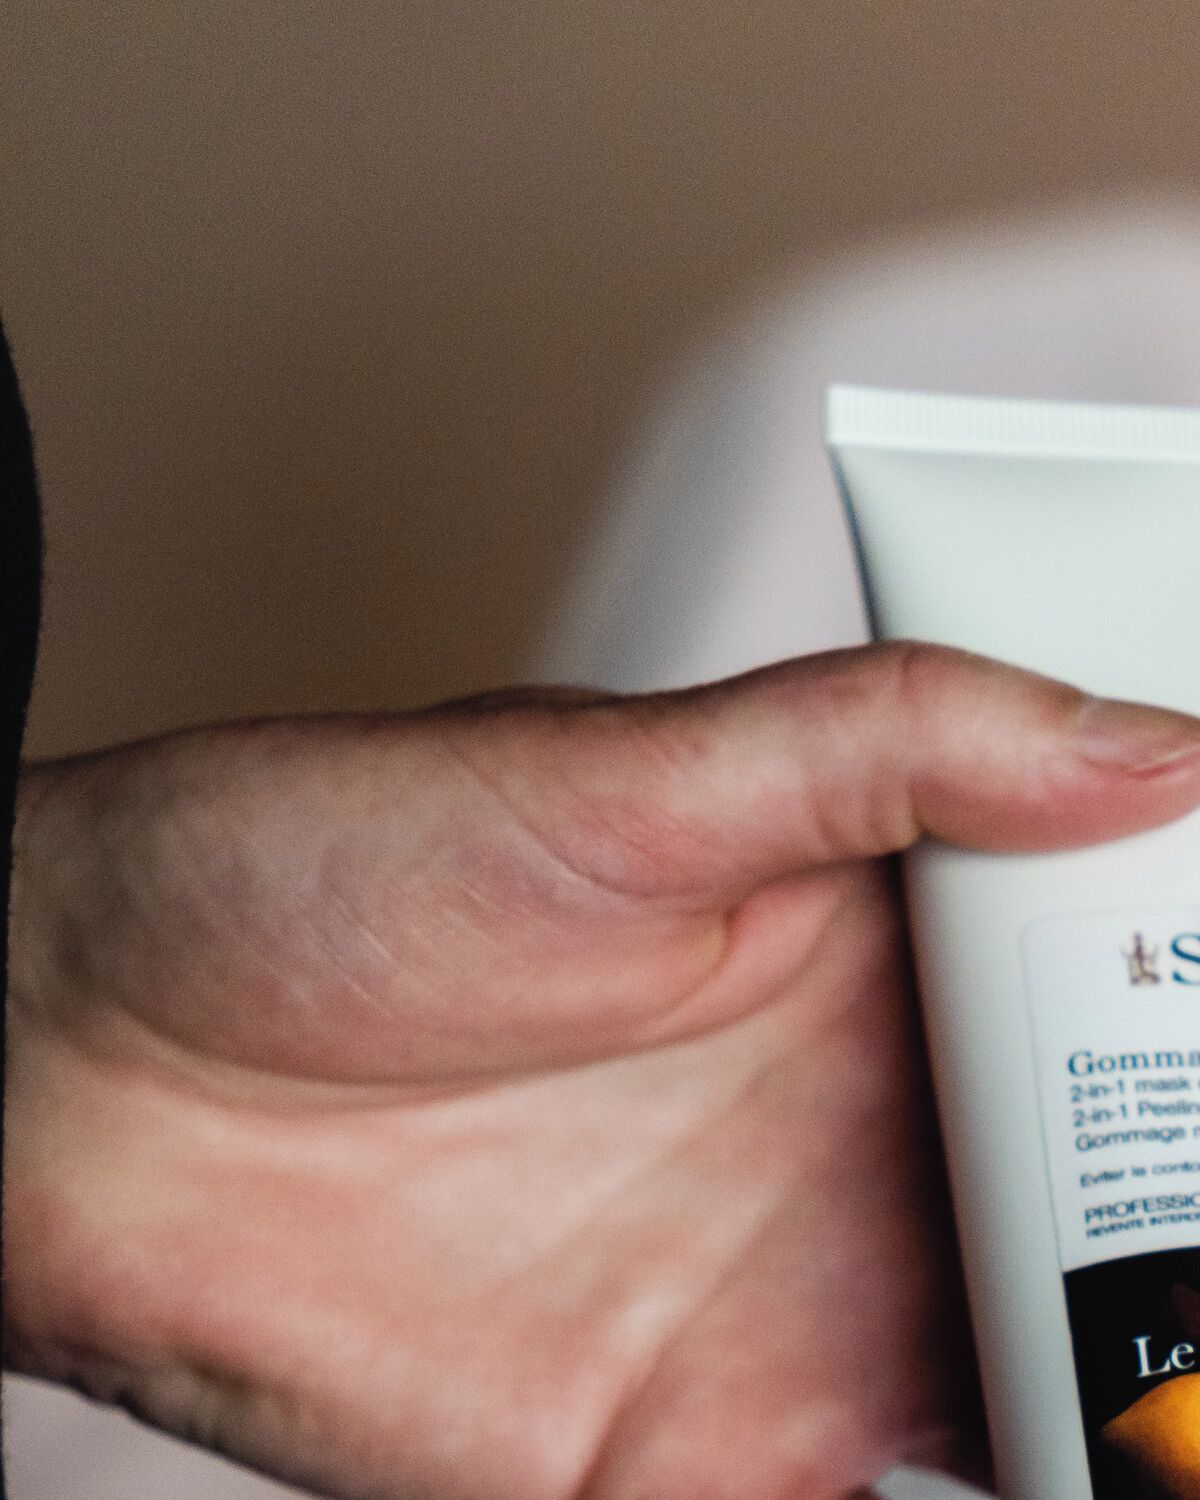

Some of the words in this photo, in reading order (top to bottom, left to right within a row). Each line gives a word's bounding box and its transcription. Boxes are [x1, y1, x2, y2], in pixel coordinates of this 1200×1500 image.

[1070, 1078, 1125, 1103] 2-in-1
[1134, 1077, 1191, 1092] mask
[1073, 1103, 1128, 1128] 2-in-1
[1075, 1125, 1186, 1151] Gommage
[1079, 1169, 1125, 1188] Eviter
[1131, 1165, 1147, 1177] le
[1086, 1218, 1144, 1239] REVENTE
[1132, 1335, 1196, 1378] Le
